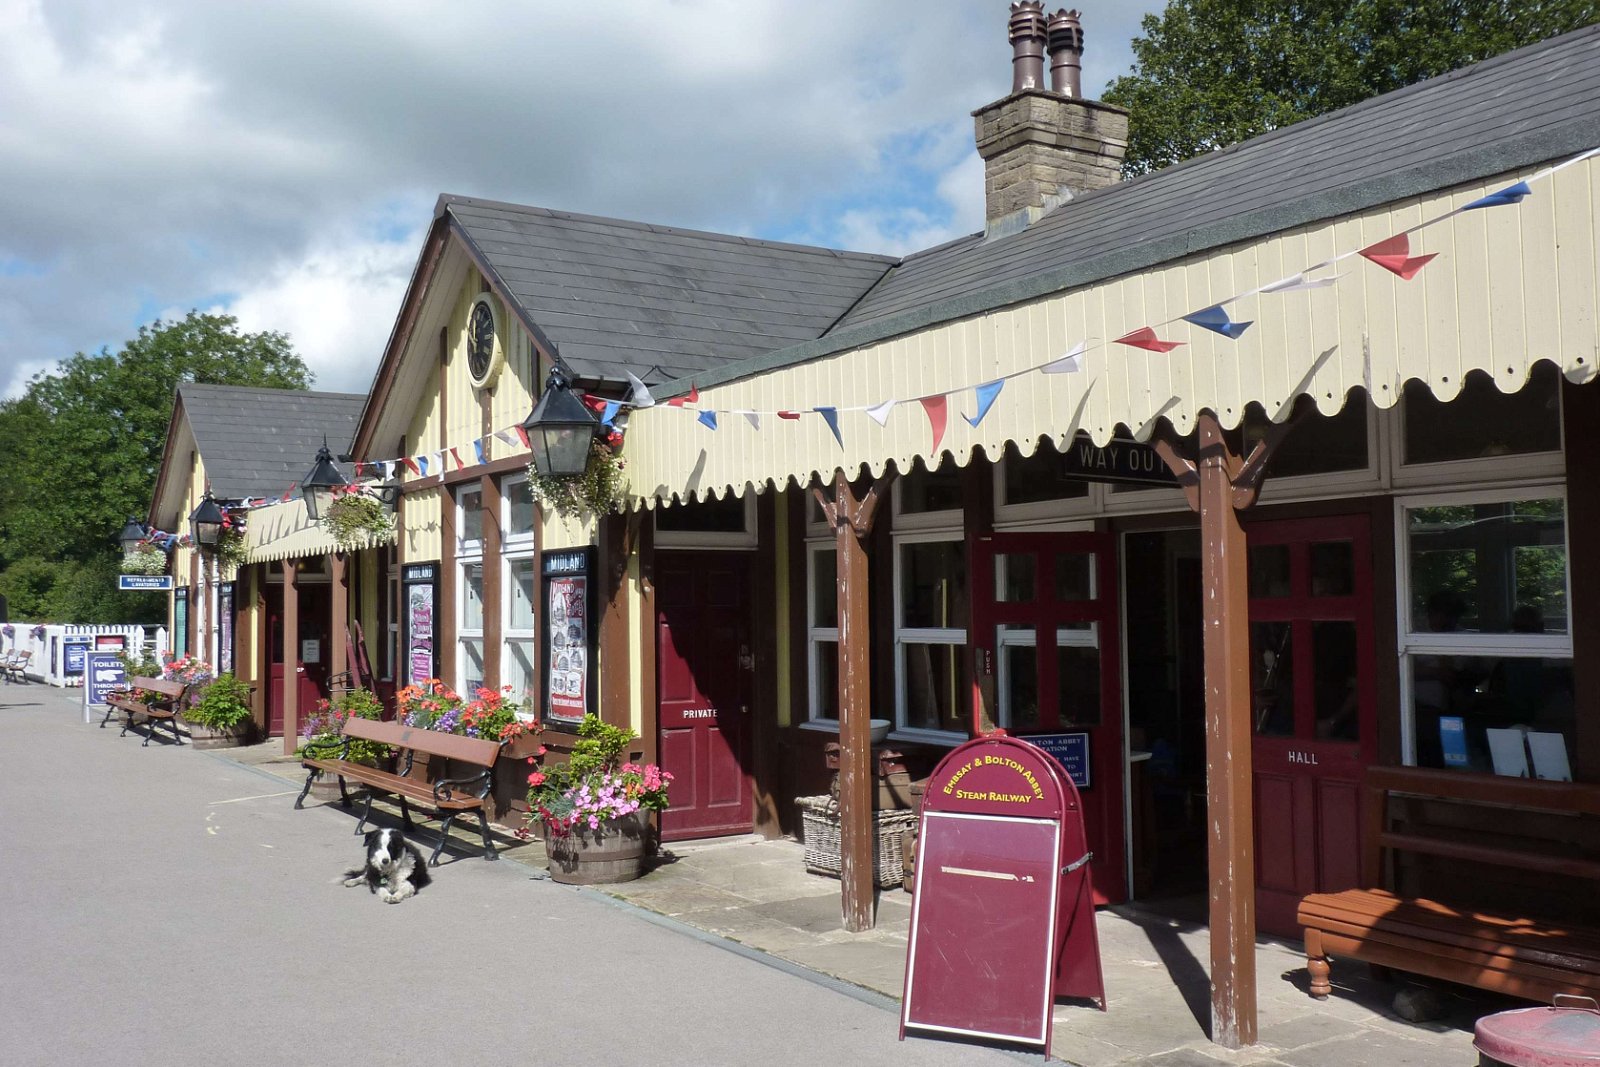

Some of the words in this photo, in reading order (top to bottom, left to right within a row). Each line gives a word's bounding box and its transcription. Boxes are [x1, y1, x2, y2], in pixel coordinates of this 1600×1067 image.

[1080, 445, 1118, 470] WAY
[551, 553, 585, 572] MIDLAND
[409, 565, 433, 578] MIDLAND
[683, 709, 718, 718] PRIVATE
[1288, 750, 1319, 765] HALL
[943, 763, 972, 795] EMBSAY
[974, 758, 983, 767] &
[984, 755, 1025, 773] BOLTON
[1023, 770, 1044, 800] ABBEY
[956, 789, 987, 800] STEAM
[989, 791, 1032, 803] RAILWAY
